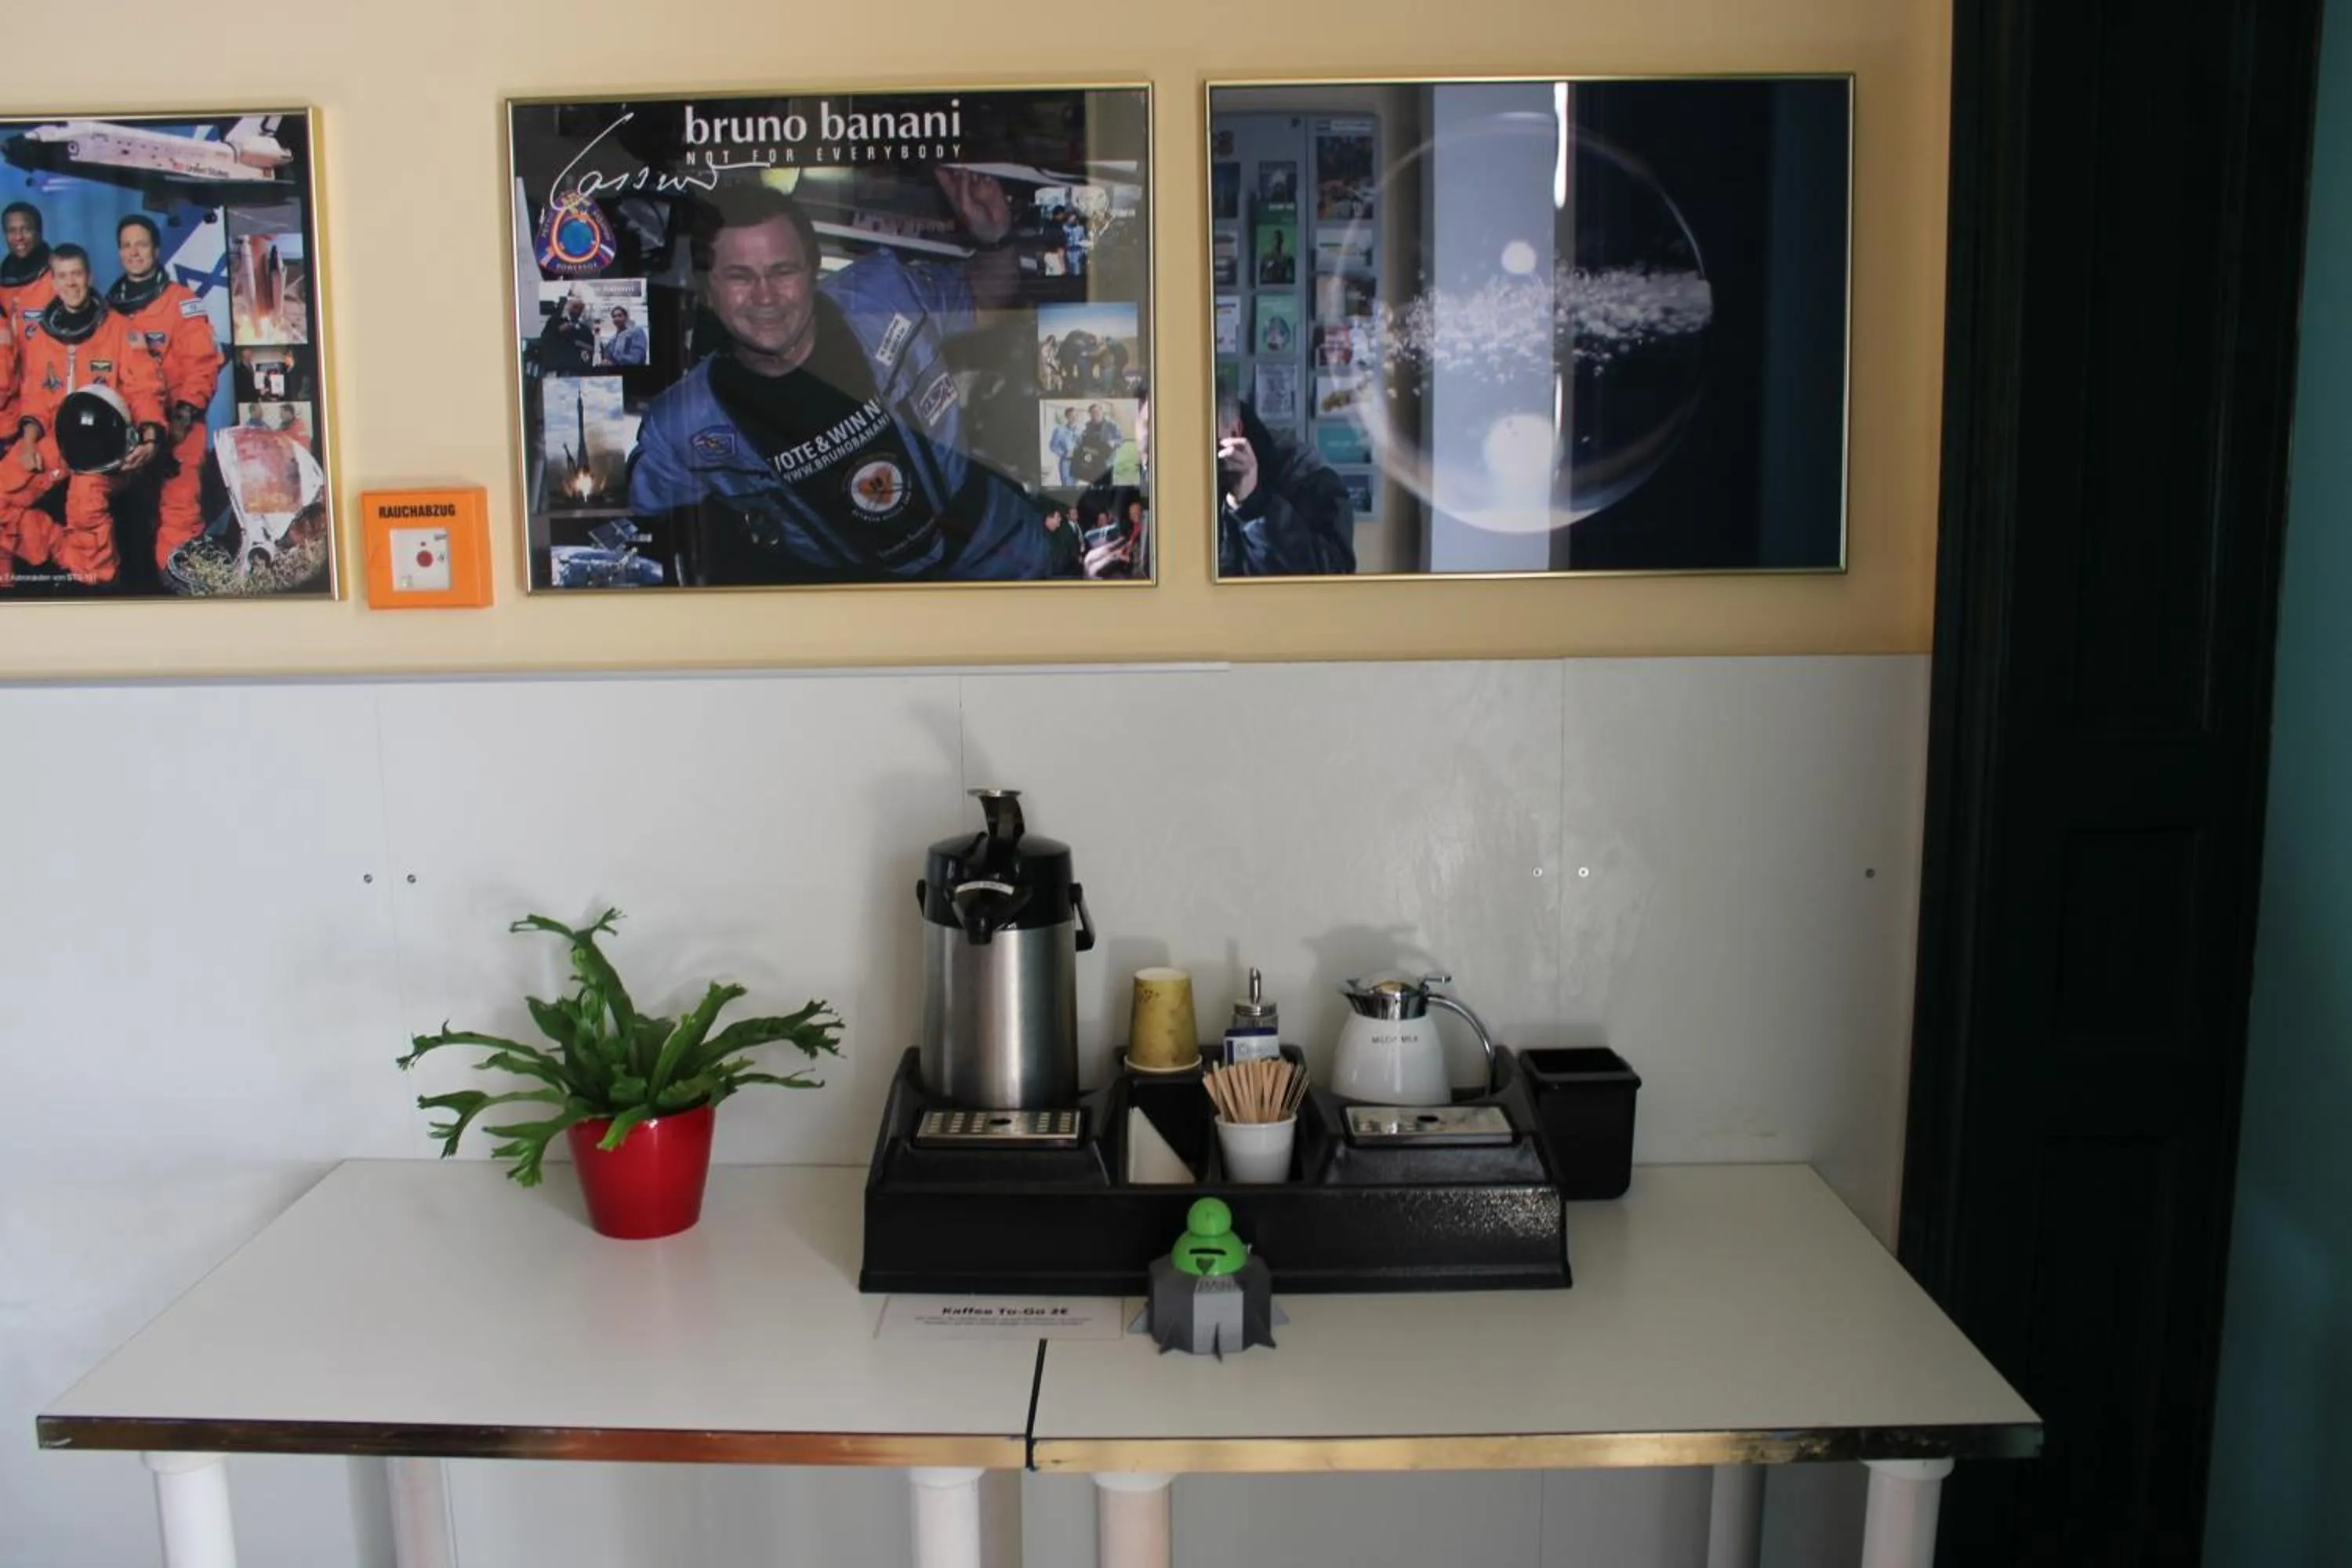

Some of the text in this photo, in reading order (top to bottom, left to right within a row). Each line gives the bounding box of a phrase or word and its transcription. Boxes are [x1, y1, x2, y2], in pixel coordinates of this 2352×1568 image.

[685, 98, 960, 145] bruno banani
[686, 143, 961, 165] NOT FOR EVERYBODY
[378, 503, 456, 519] RAUCHABZUG
[941, 1306, 993, 1316] Kaffee
